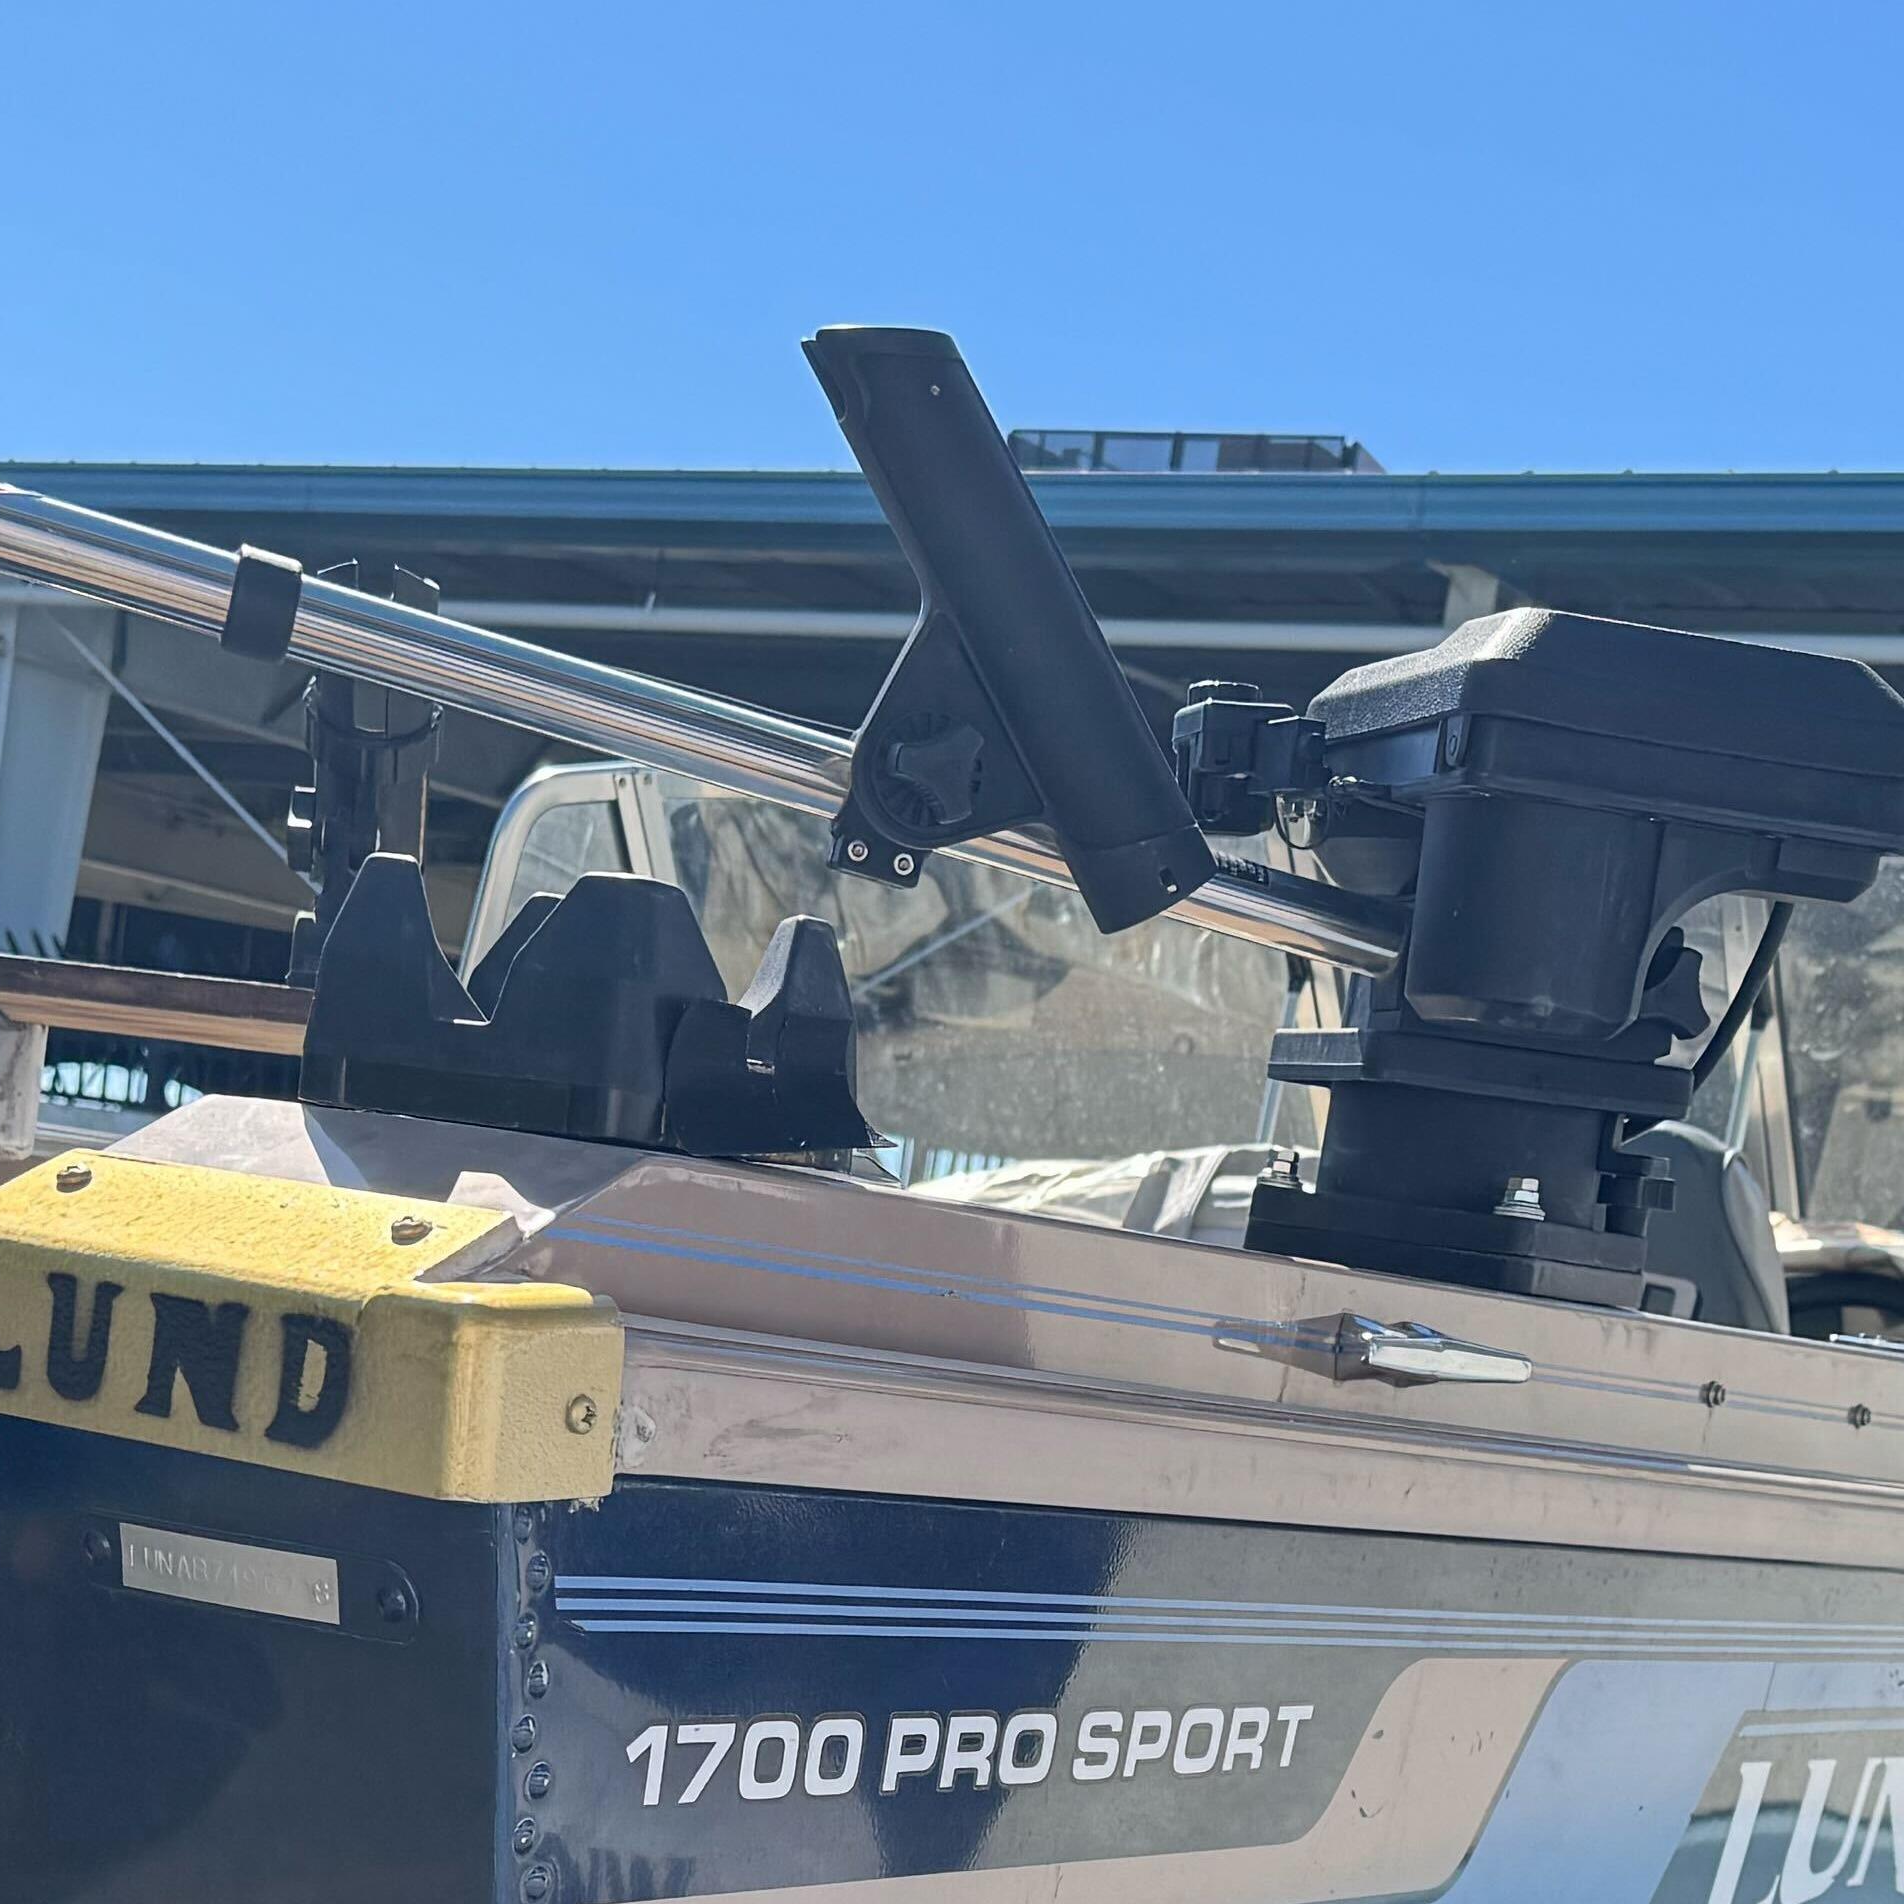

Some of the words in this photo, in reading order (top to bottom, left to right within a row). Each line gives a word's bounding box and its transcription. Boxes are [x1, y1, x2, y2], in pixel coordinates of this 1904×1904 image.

[625, 1719, 865, 1807] 1700
[880, 1713, 1056, 1793] PRO
[1072, 1704, 1314, 1782] SPORT
